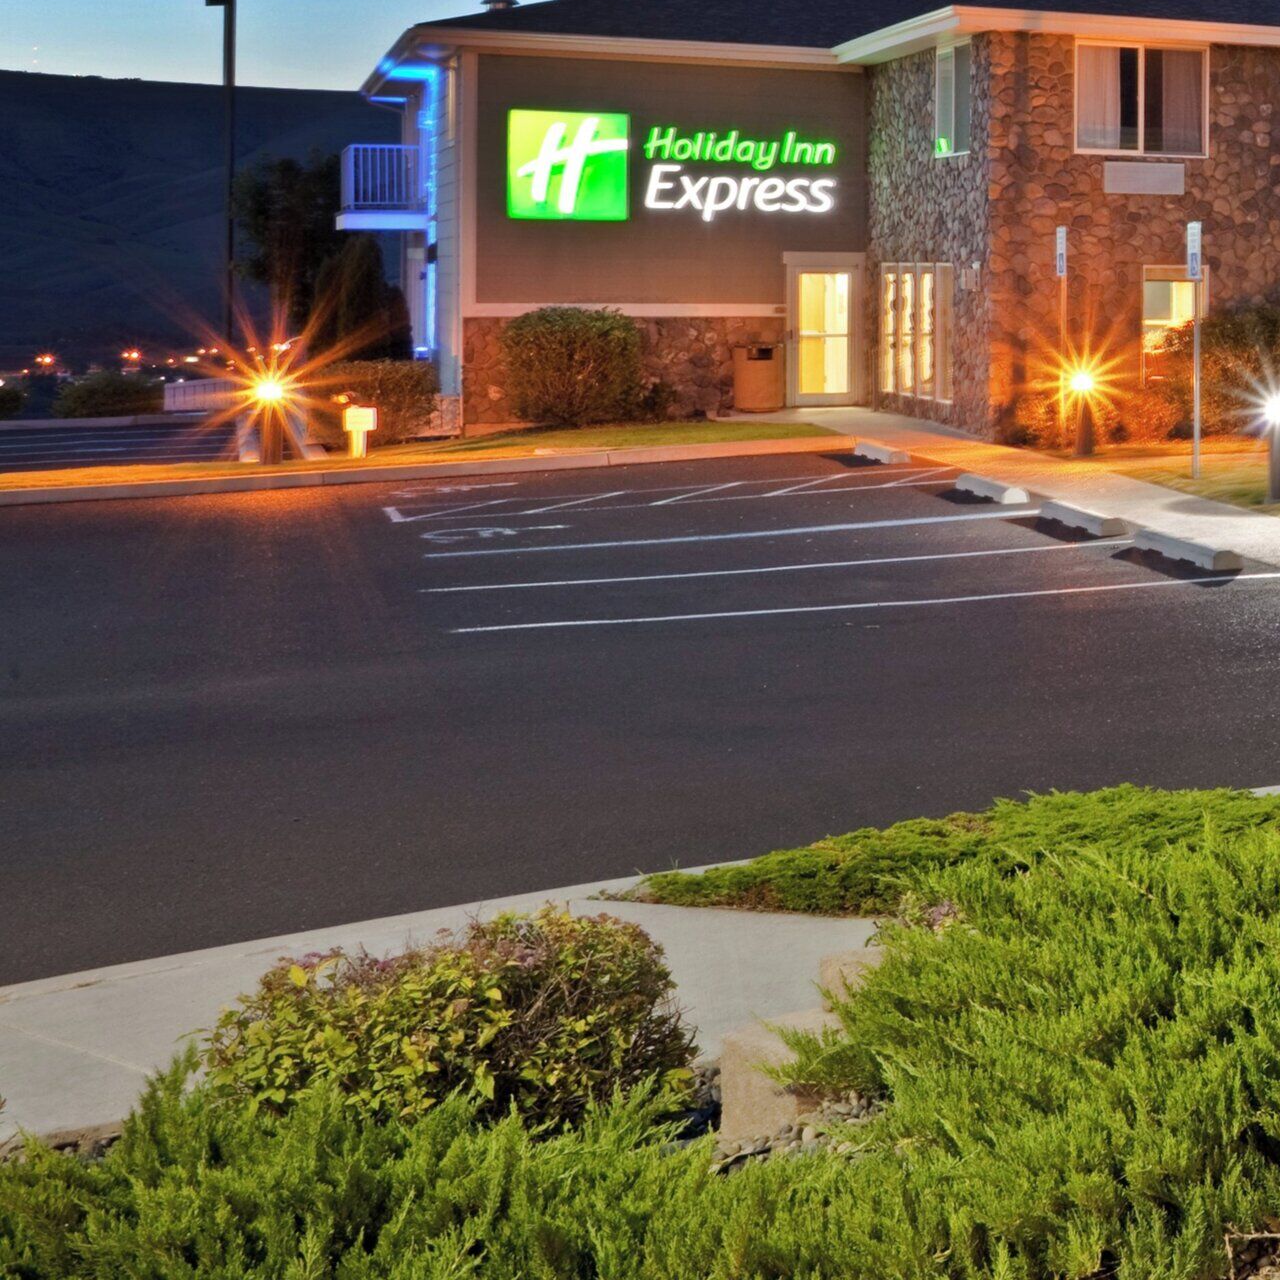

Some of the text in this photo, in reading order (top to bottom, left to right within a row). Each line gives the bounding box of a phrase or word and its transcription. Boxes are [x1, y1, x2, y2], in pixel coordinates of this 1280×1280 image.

[645, 126, 835, 170] Holiday Inn
[645, 164, 837, 222] Express
